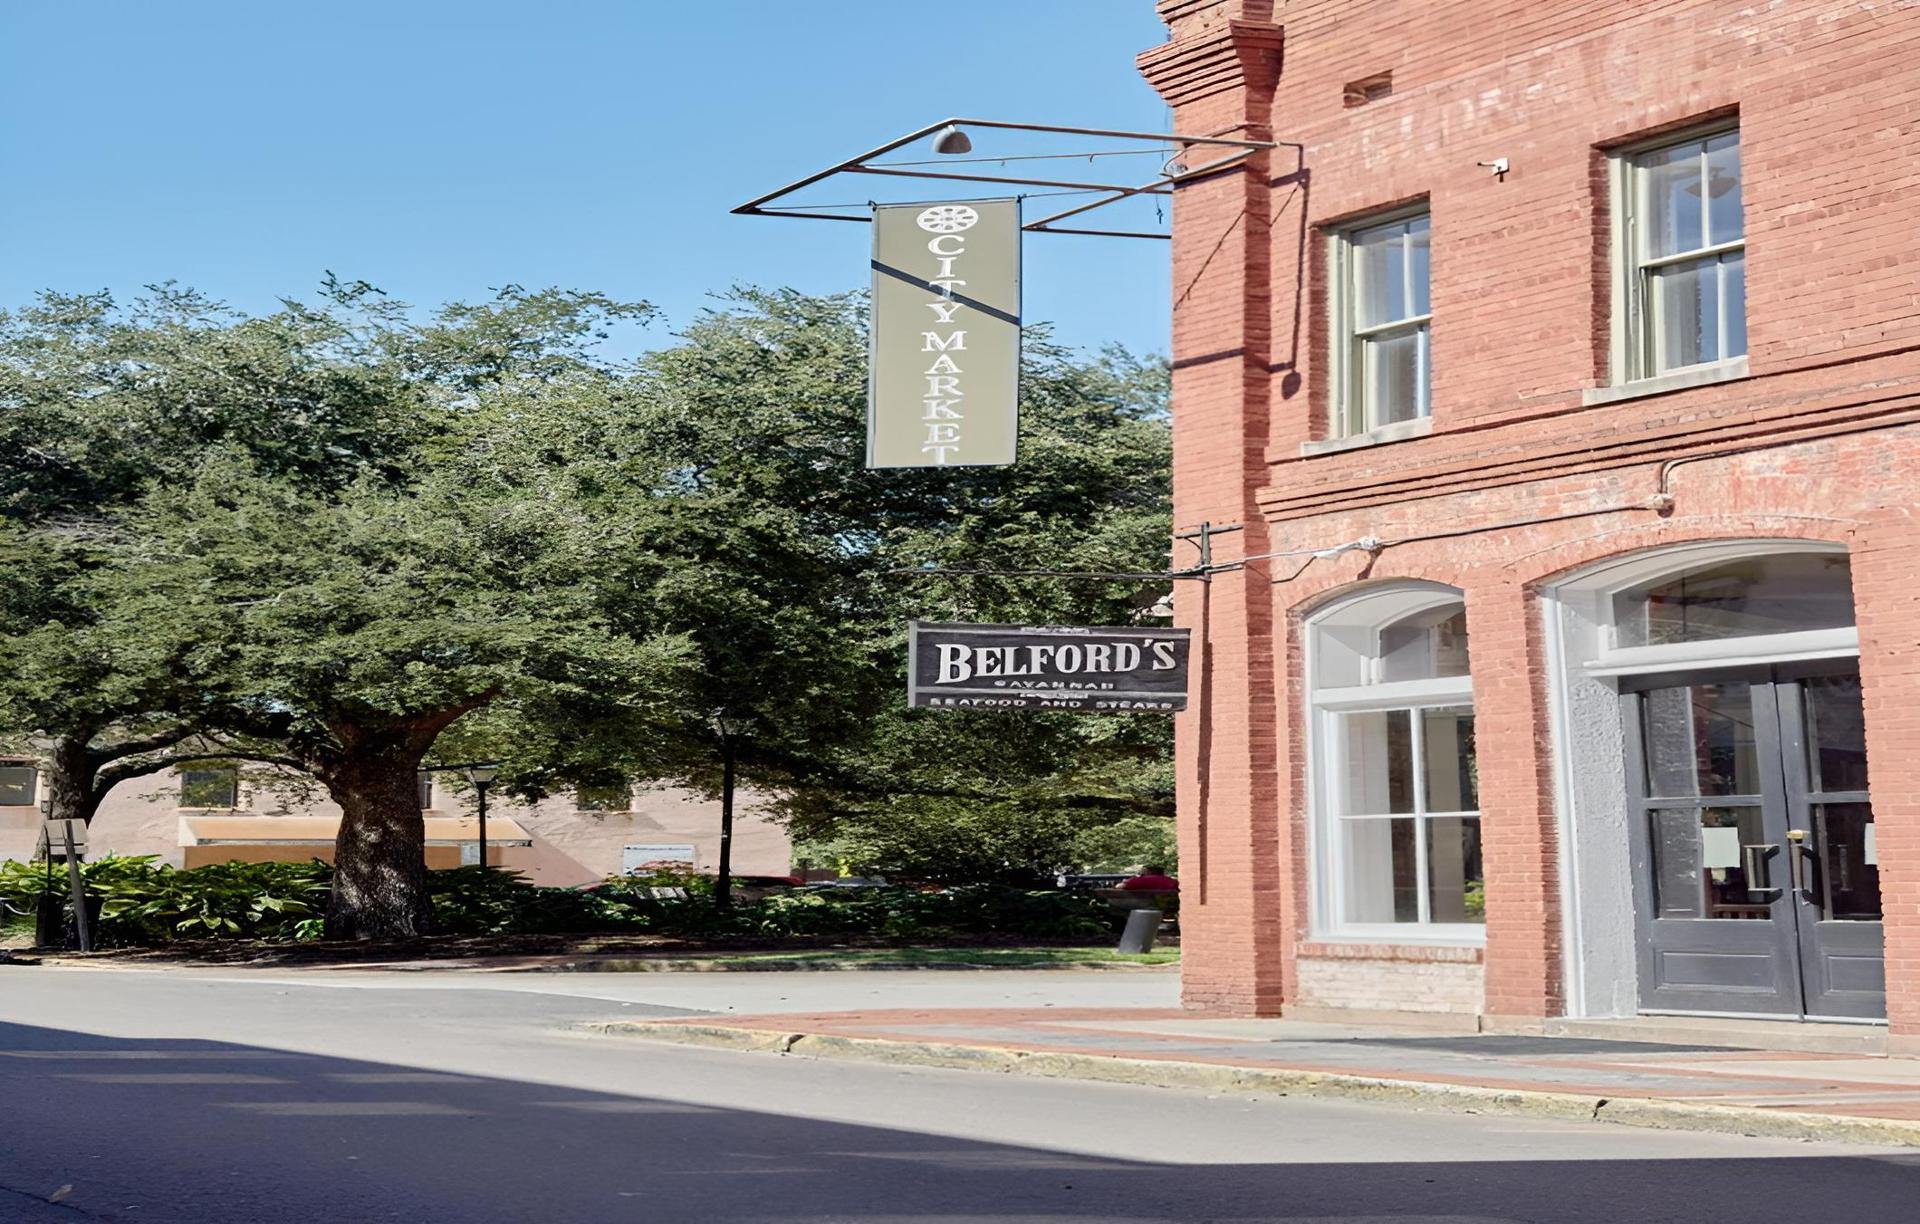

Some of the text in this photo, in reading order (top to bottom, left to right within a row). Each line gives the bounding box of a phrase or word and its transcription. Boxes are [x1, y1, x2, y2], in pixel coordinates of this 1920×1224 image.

[920, 235, 968, 466] CITY MARKET
[935, 638, 1177, 684] BELFORD'S
